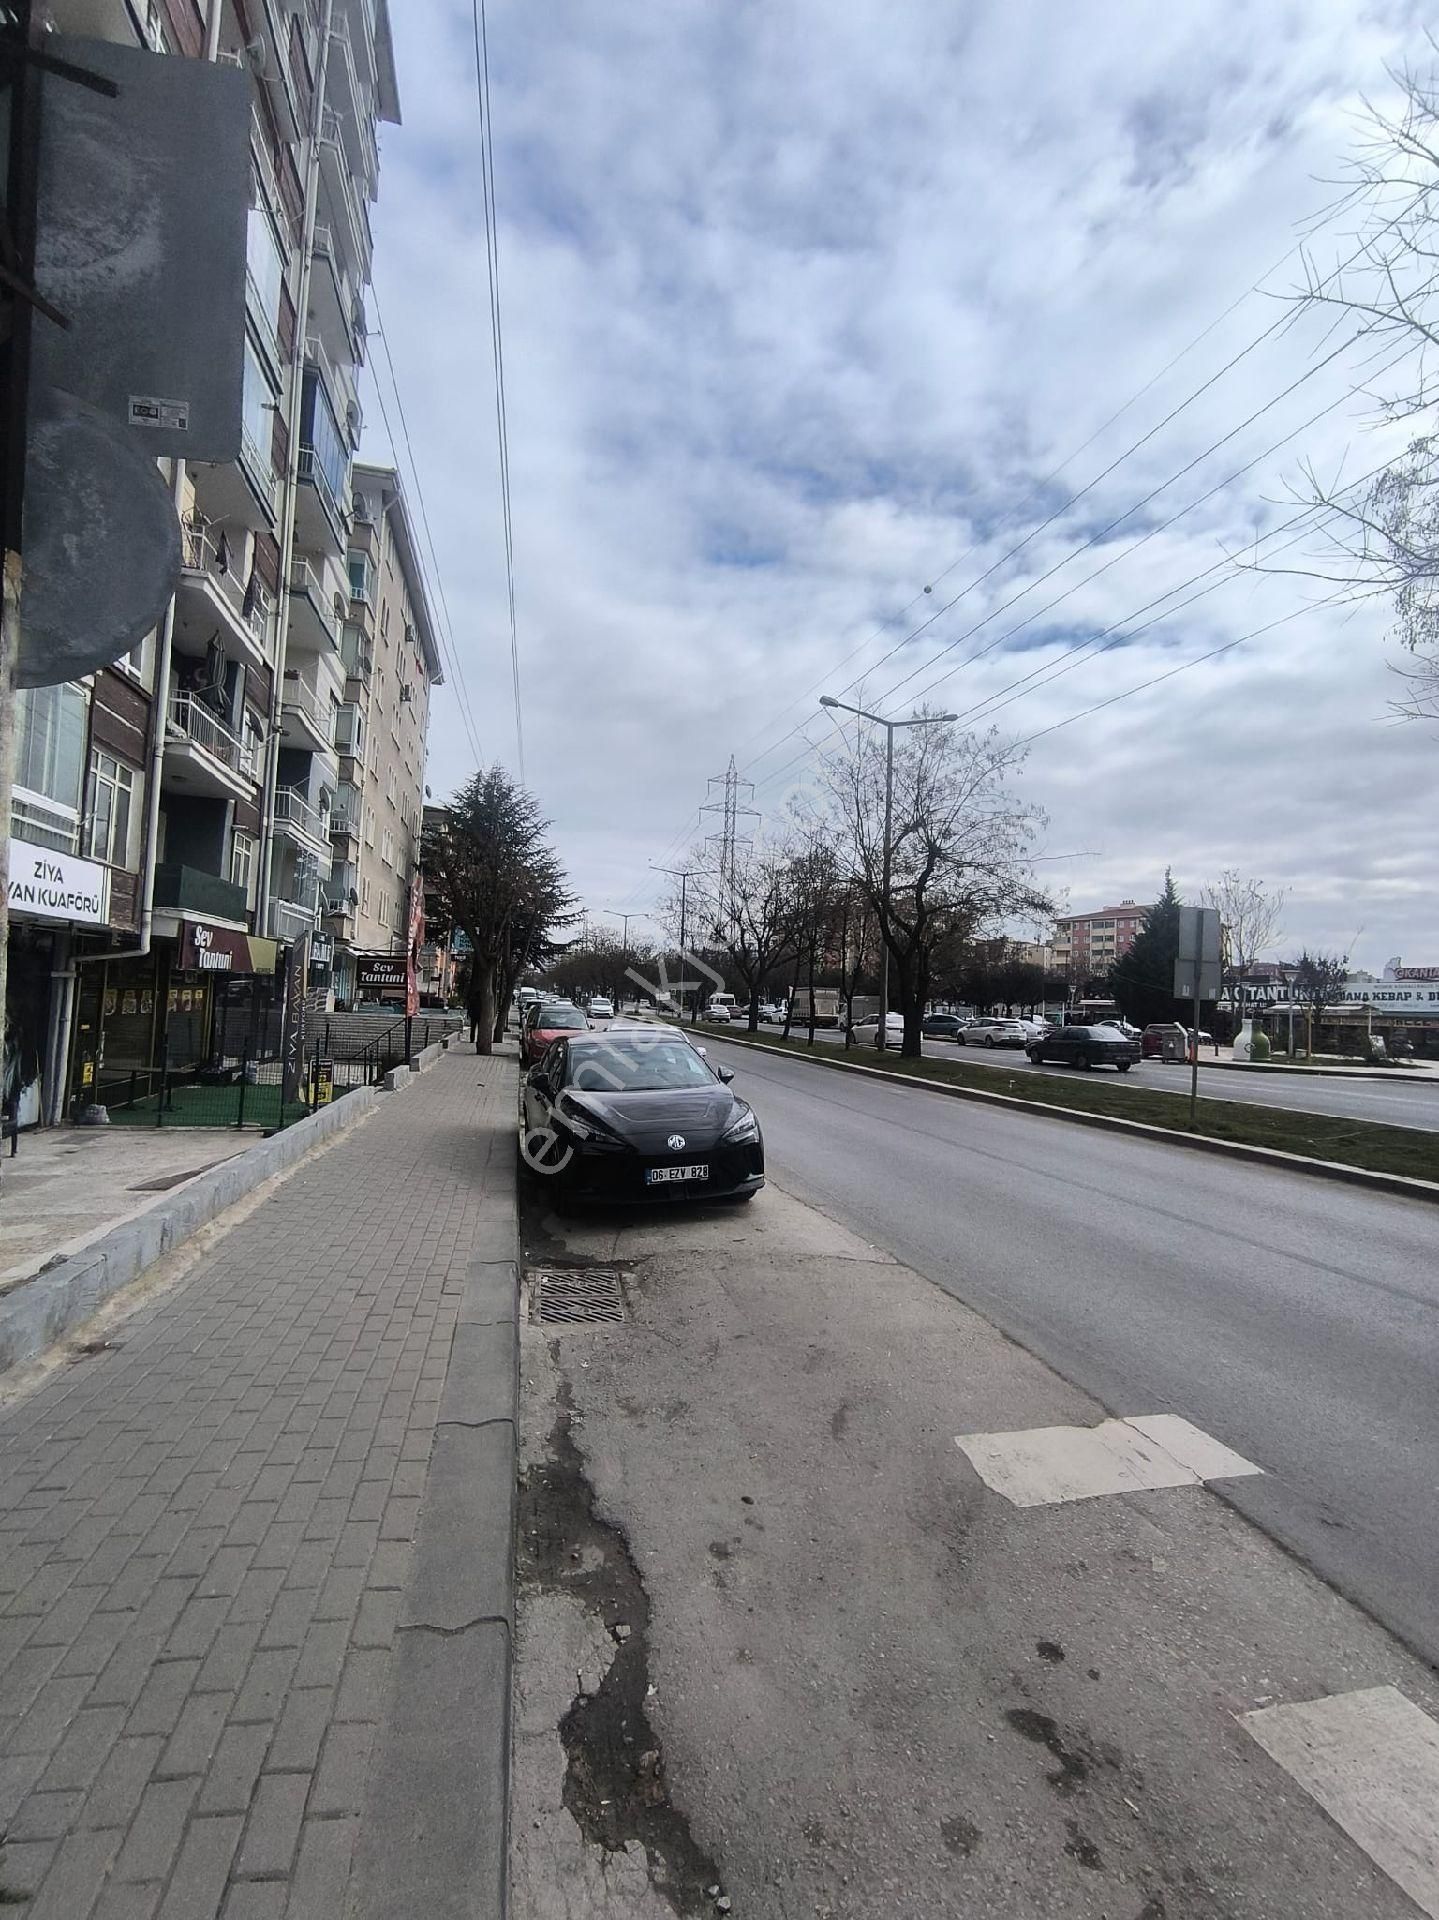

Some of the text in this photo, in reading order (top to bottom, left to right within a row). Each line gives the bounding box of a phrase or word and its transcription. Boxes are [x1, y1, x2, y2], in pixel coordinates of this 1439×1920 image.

[33, 859, 64, 884] ZİYA
[194, 925, 214, 948] Sev
[199, 948, 233, 970] Tantuni
[1371, 991, 1412, 1001] KEBAP
[652, 1170, 663, 1181] 06
[669, 1168, 686, 1179] EZV
